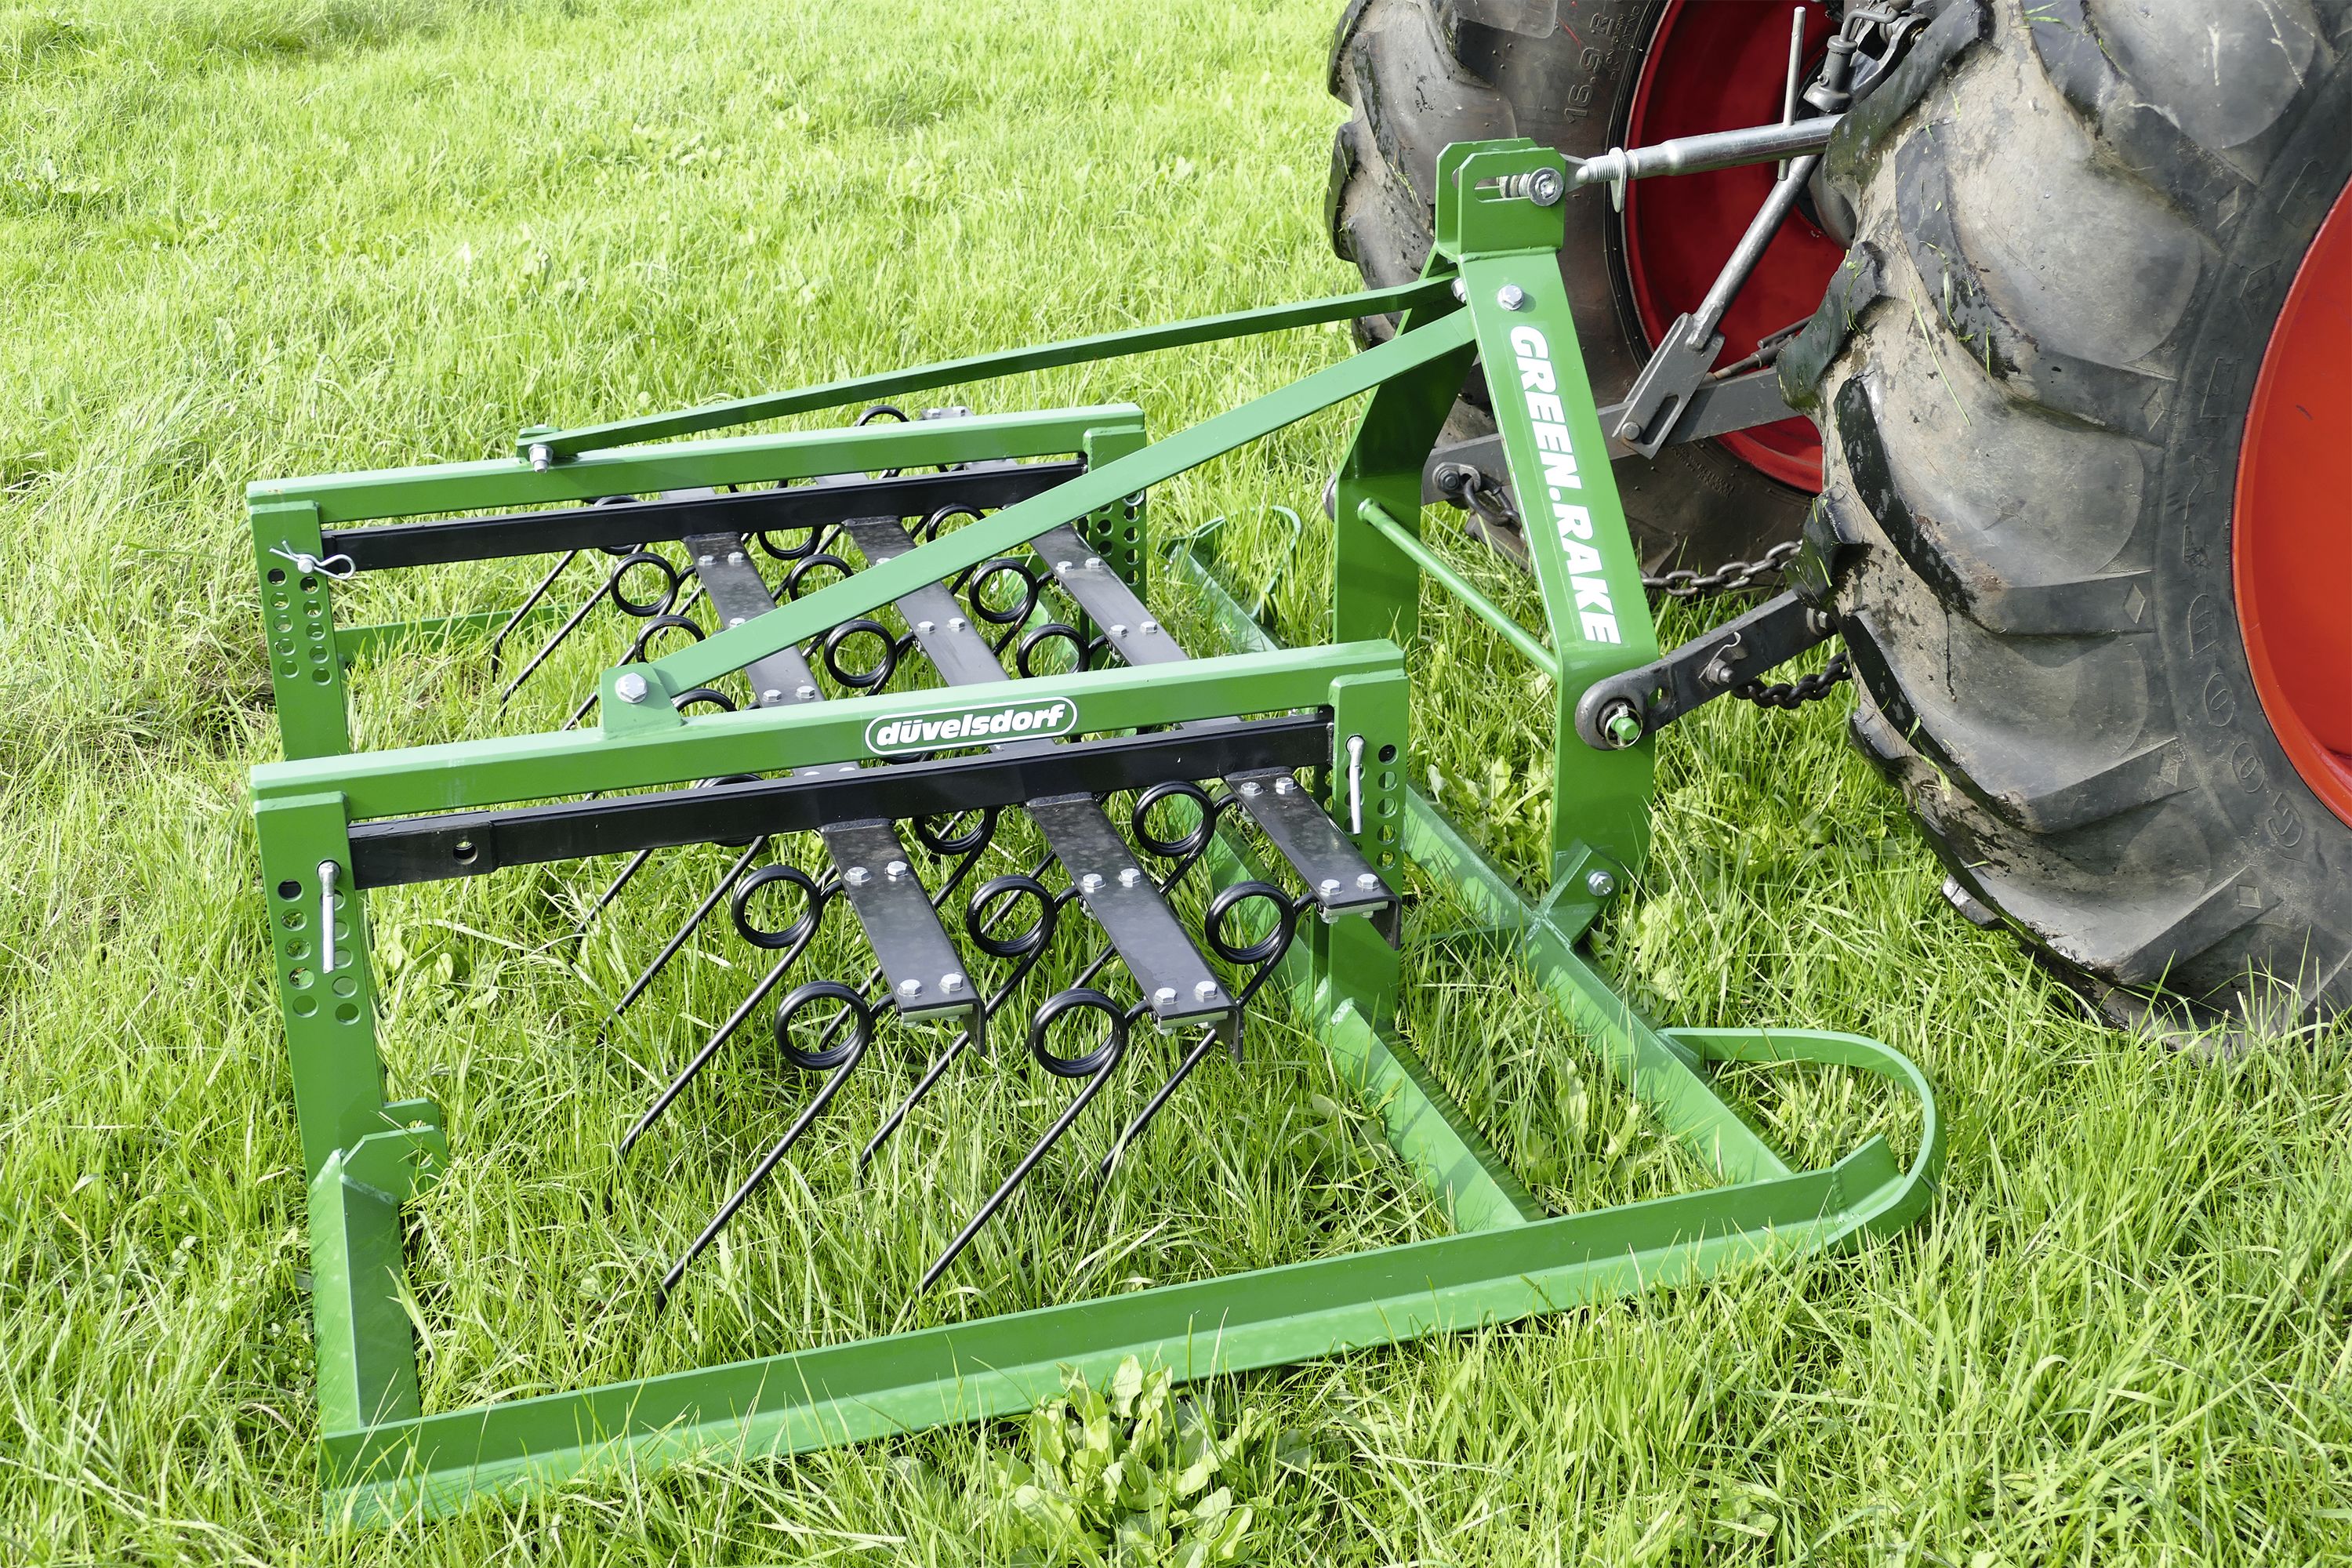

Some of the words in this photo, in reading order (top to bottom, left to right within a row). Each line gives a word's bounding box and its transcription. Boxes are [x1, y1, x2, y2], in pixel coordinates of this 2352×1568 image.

[1564, 47, 1603, 124] 16.9
[1510, 325, 1622, 644] GREEN.RAKE
[876, 704, 1065, 746] düvelsdorf
